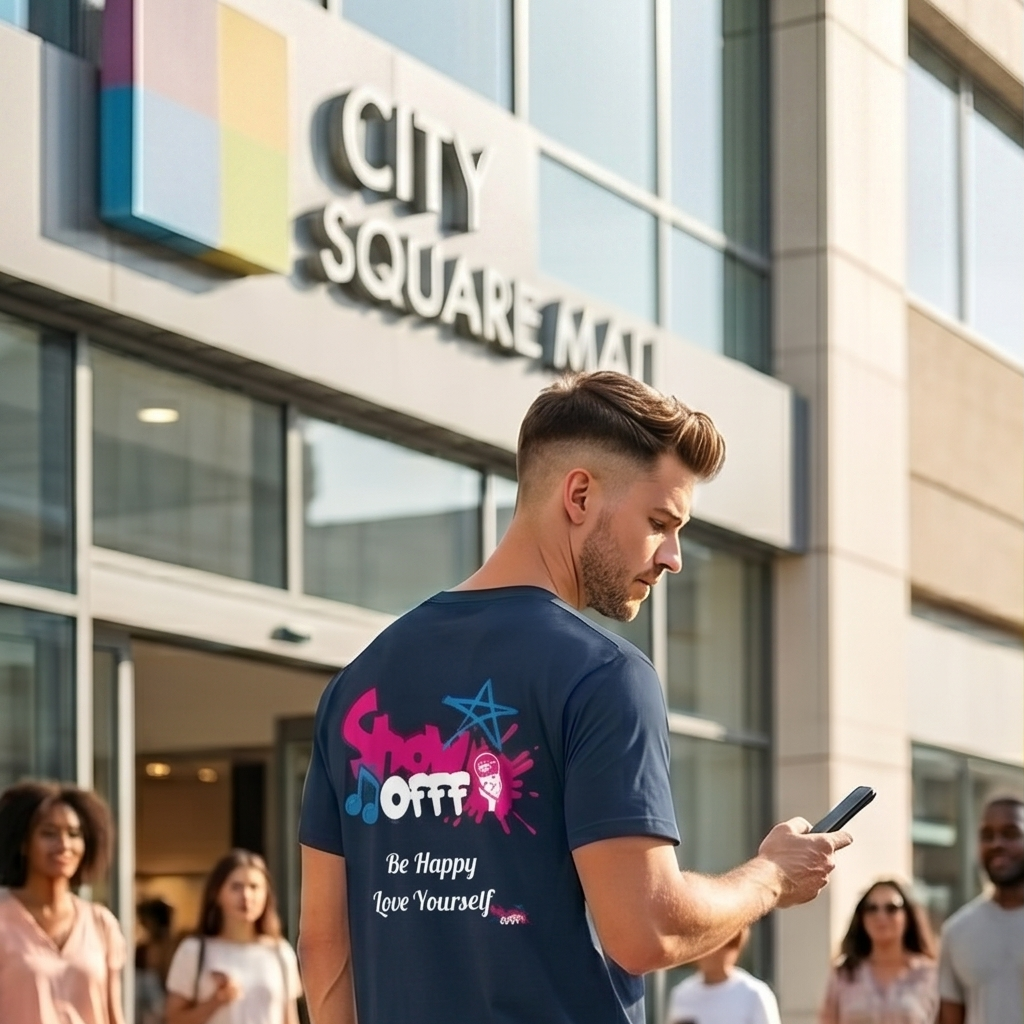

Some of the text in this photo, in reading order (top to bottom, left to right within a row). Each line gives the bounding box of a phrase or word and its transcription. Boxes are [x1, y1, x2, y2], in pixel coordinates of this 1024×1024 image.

[341, 86, 497, 233] CITY
[320, 203, 543, 359] SQUARE
[373, 890, 410, 917] Love
[413, 889, 495, 917] Yourself
[386, 852, 477, 880] Be Happy
